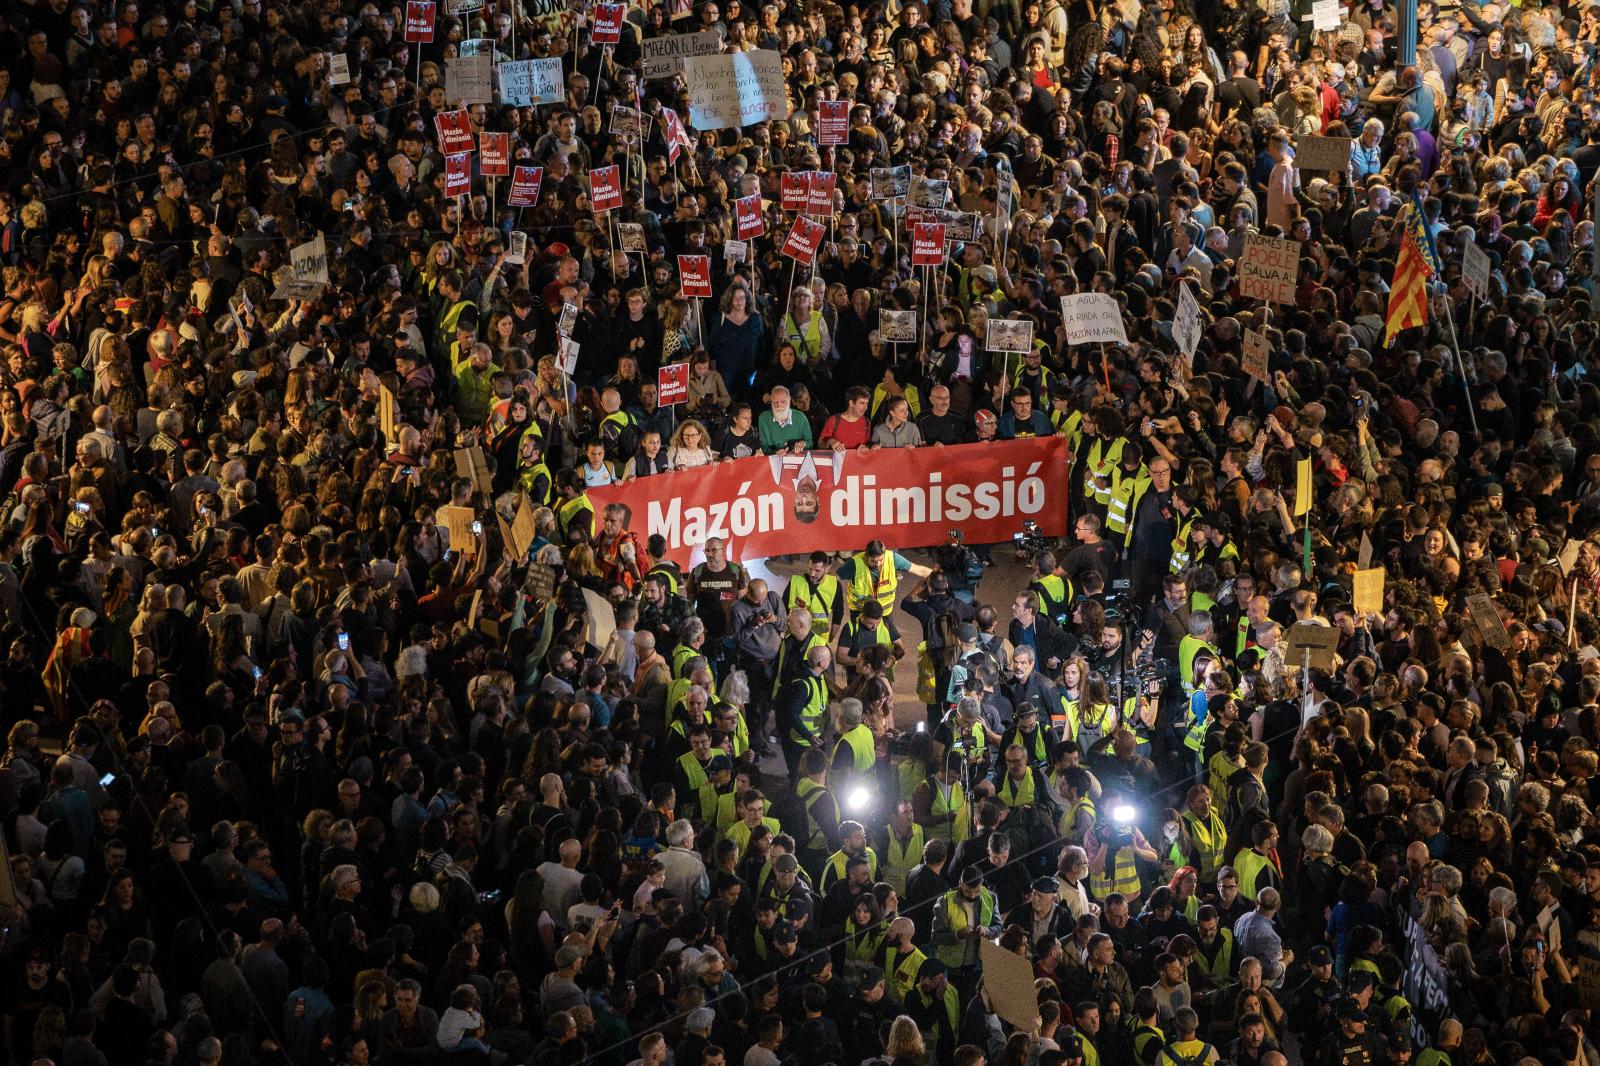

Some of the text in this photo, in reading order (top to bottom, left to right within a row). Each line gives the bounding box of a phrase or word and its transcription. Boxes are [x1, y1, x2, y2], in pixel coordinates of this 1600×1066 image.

[408, 18, 427, 26] Mazón
[595, 19, 615, 27] Mazón
[594, 26, 619, 34] dimissió
[645, 61, 671, 76] EXIGE
[514, 73, 546, 86] VETE A
[444, 127, 464, 137] Mazón
[445, 133, 471, 144] dimissió
[481, 149, 501, 158] Mazón
[481, 157, 507, 165] dimissió
[447, 171, 465, 181] Mazón
[447, 177, 469, 188] dimissió
[593, 185, 613, 194] Mazón
[783, 187, 804, 195] Mazón
[809, 188, 827, 198] Mazón
[594, 190, 620, 201] dimissió
[739, 213, 756, 224] Mazón
[740, 218, 762, 231] dimissió
[790, 231, 810, 246] Mazón
[915, 239, 936, 248] Mazón
[787, 239, 814, 255] dimissió
[914, 247, 942, 255] dimissió
[1286, 241, 1298, 254] EL
[1248, 247, 1295, 271] POBLE
[682, 271, 702, 280] Mazón
[1243, 262, 1295, 285] SALVA AL
[683, 279, 709, 287] dimissió
[1243, 277, 1290, 304] POBLE
[1063, 299, 1073, 308] EL
[1078, 295, 1102, 306] AGUA
[1077, 311, 1099, 322] RIADA
[660, 381, 680, 391] Mazón
[660, 386, 687, 397] dimissió
[647, 461, 1046, 549] Mazón dimissió
